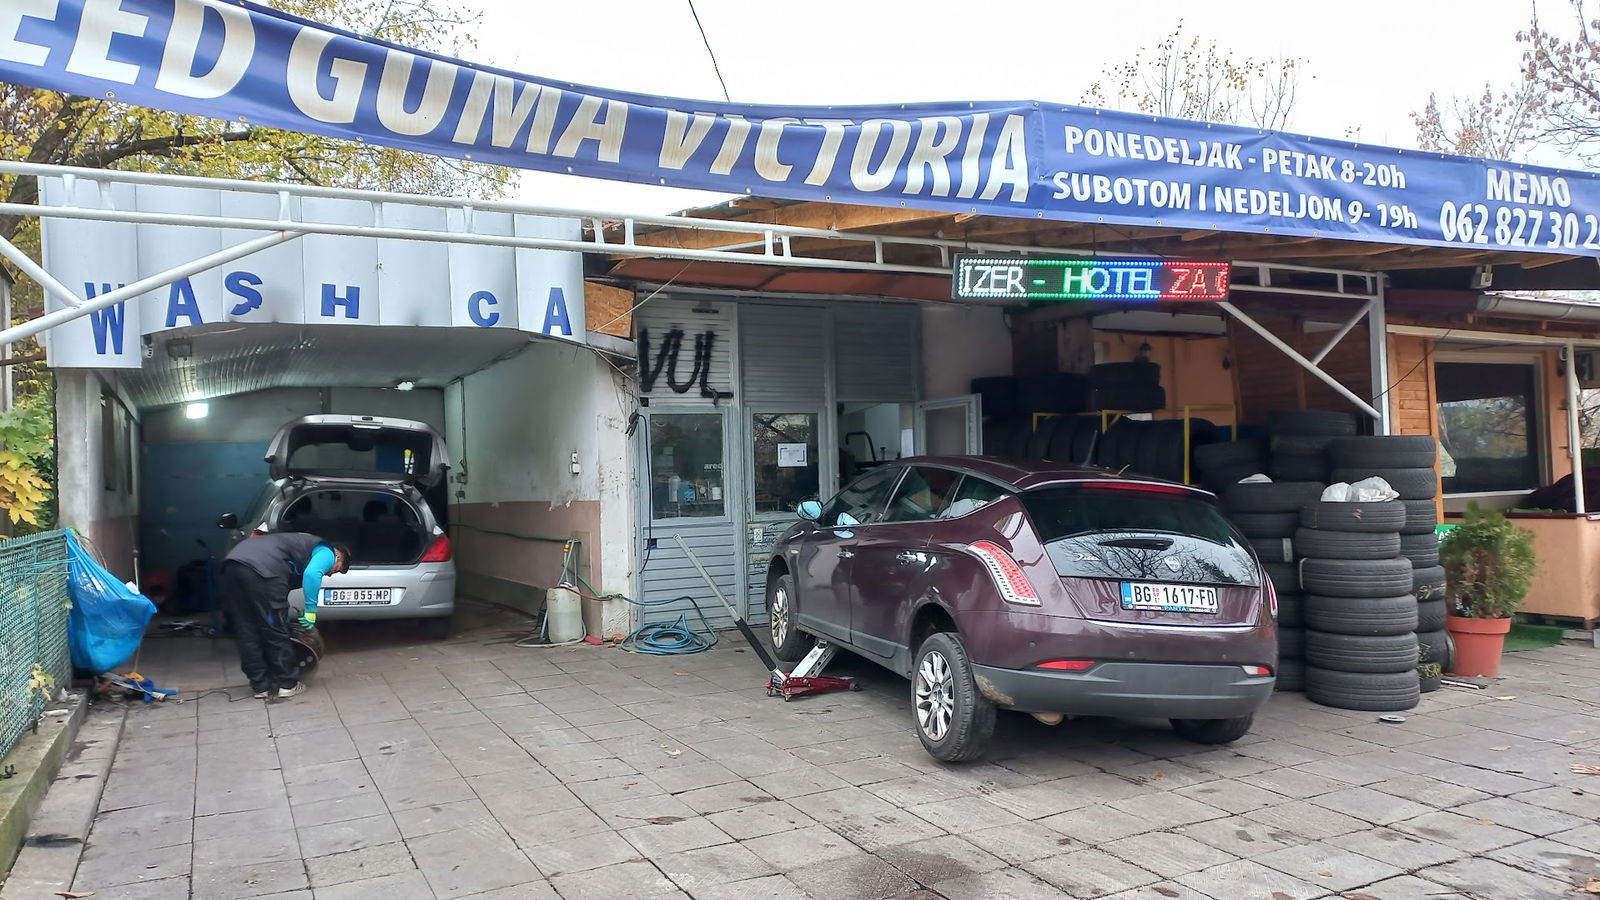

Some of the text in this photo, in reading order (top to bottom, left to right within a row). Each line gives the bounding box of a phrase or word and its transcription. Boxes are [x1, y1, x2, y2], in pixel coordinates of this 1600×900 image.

[286, 26, 629, 163] GUMA
[658, 109, 1030, 203] VICTORIA
[1064, 125, 1243, 170] PONEDELJAK
[1262, 148, 1337, 181] PETAK
[1340, 160, 1406, 189] 8-20h
[1052, 171, 1192, 210] SUBOTOM
[1198, 184, 1207, 211] I
[1214, 186, 1344, 222] NEDELJOM
[1377, 203, 1418, 229] 19h
[1486, 168, 1571, 207] MEMO
[1439, 200, 1600, 250] 062 827 30 2
[962, 265, 1026, 293] IZER
[1062, 267, 1161, 294] HOTEL
[1170, 268, 1207, 294] ZA
[84, 270, 573, 355] WASH CA
[639, 327, 734, 399] VUL
[333, 590, 346, 601] BG
[1133, 585, 1152, 603] BG
